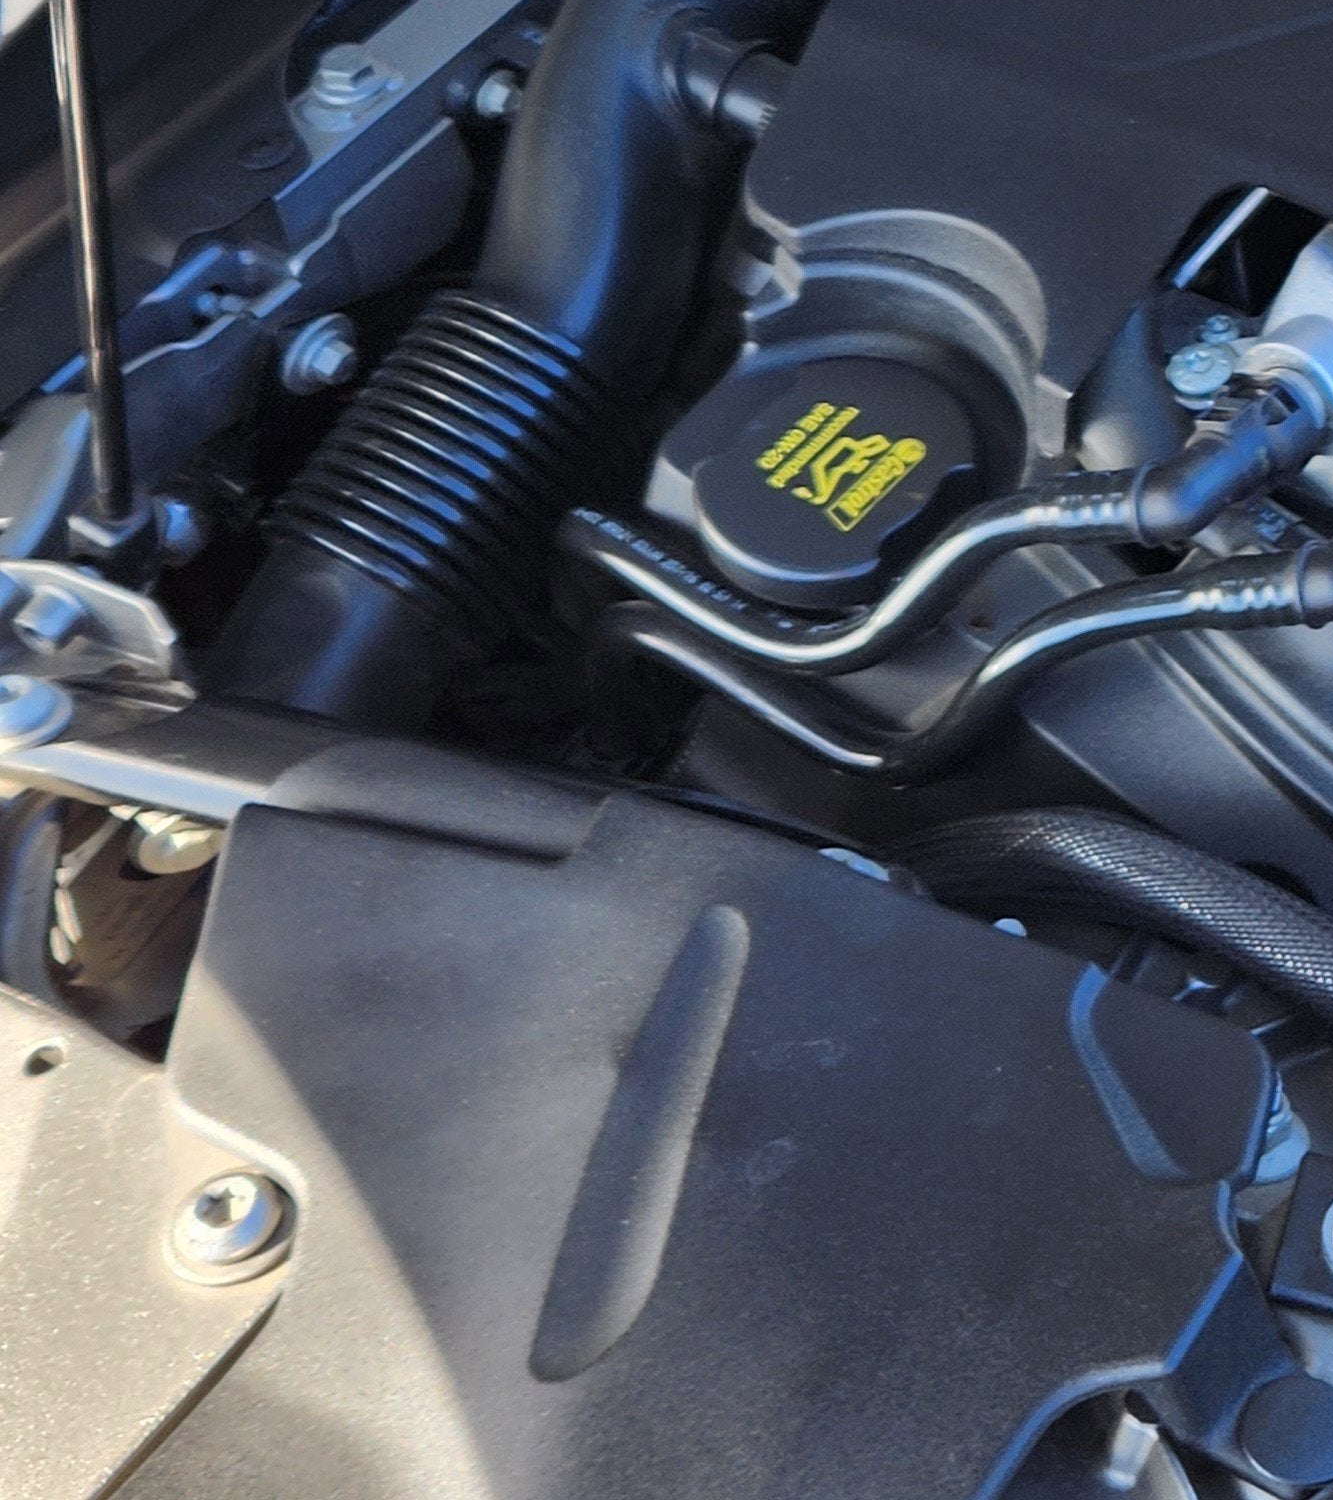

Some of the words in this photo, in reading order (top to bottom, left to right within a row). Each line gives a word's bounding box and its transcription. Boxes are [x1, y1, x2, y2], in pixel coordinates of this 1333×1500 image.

[797, 403, 836, 432] SAE
[756, 429, 806, 470] 0W-20
[838, 454, 906, 517] Castrol
